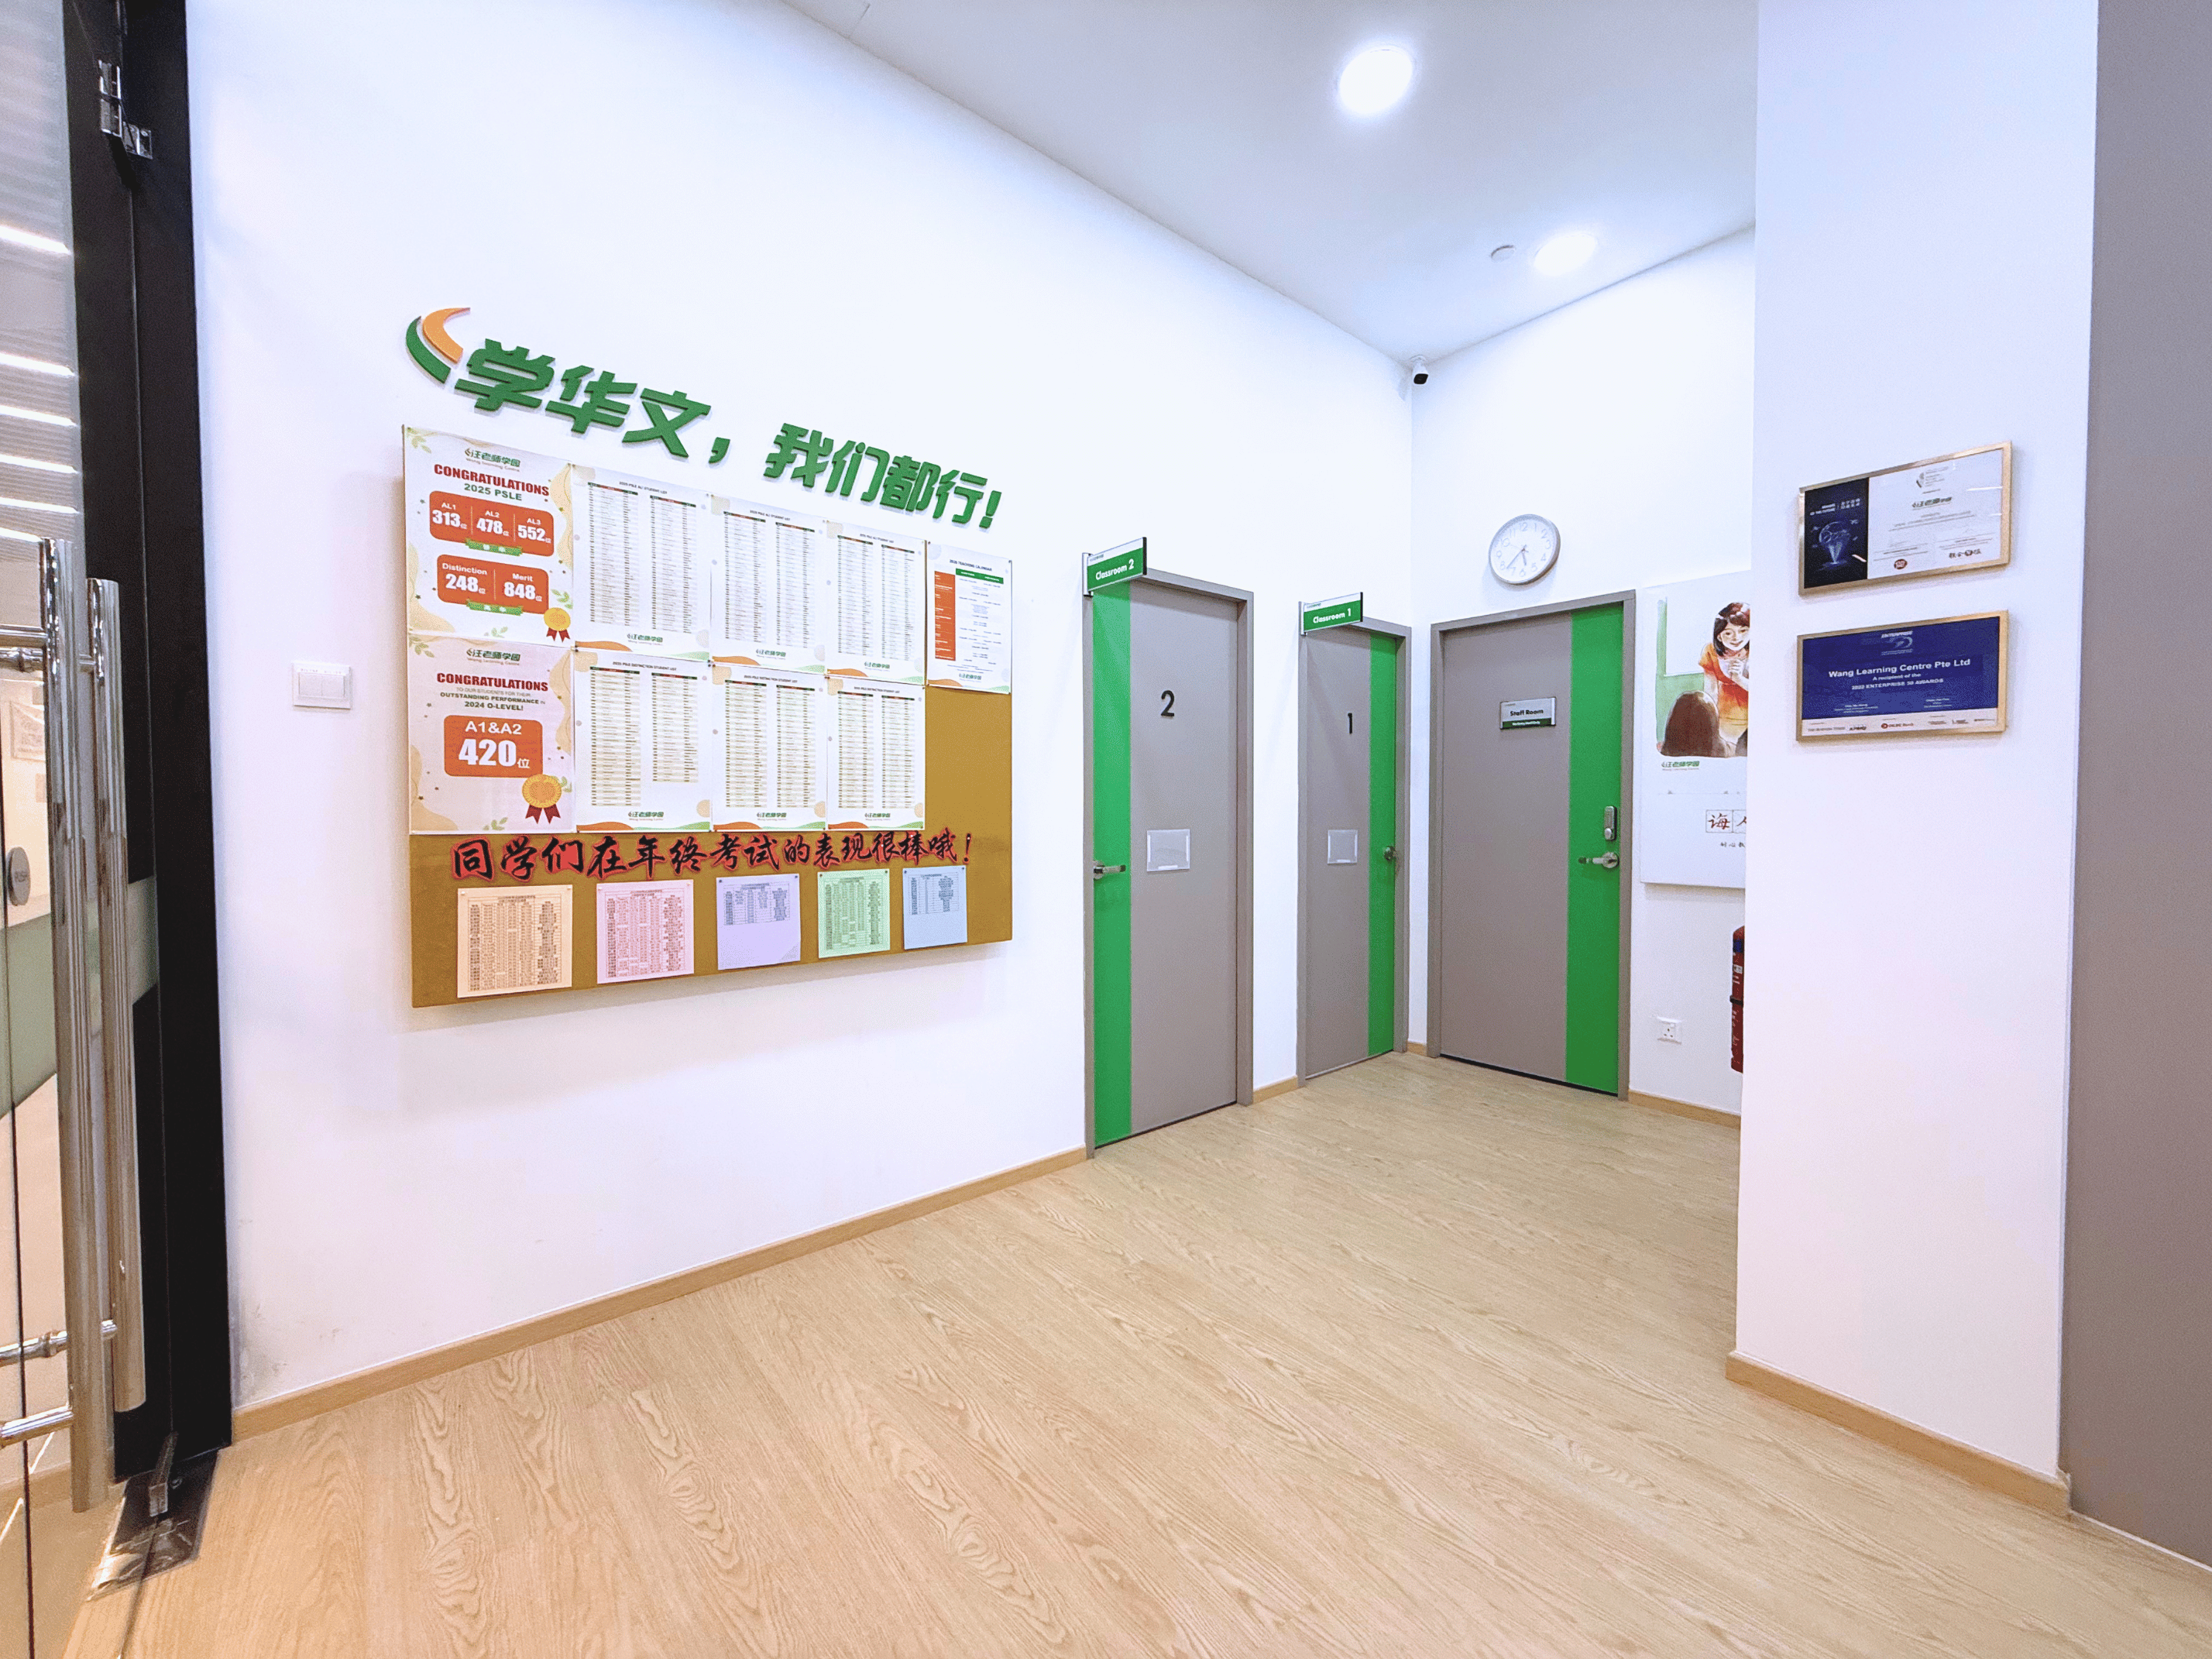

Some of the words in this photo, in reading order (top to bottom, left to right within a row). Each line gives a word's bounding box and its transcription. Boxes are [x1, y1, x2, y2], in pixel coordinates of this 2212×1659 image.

[434, 464, 549, 496] CONGRATULATIONS
[464, 483, 491, 495] 2025
[494, 489, 523, 501] PSLE
[441, 502, 456, 510] AL1
[527, 517, 541, 526] AL3
[1541, 528, 1548, 539] 2
[1540, 553, 1546, 561] 4
[442, 563, 488, 575] Distinction
[512, 573, 534, 582] Merit
[1096, 565, 1127, 580] Classroom
[1128, 558, 1134, 570] 2
[1313, 612, 1345, 623] Classroom
[1347, 608, 1351, 617] 1
[1856, 666, 1897, 676] Learning
[1953, 659, 1971, 667] Ltd
[436, 672, 548, 692] CONGRATULATIONS
[440, 692, 489, 701] OUTSTANDING
[491, 696, 539, 704] PERFORMANCE
[487, 702, 524, 711] O-LEVEL!
[1161, 689, 1175, 718] 2
[465, 720, 522, 735] A1&A2
[1347, 712, 1353, 735] 1
